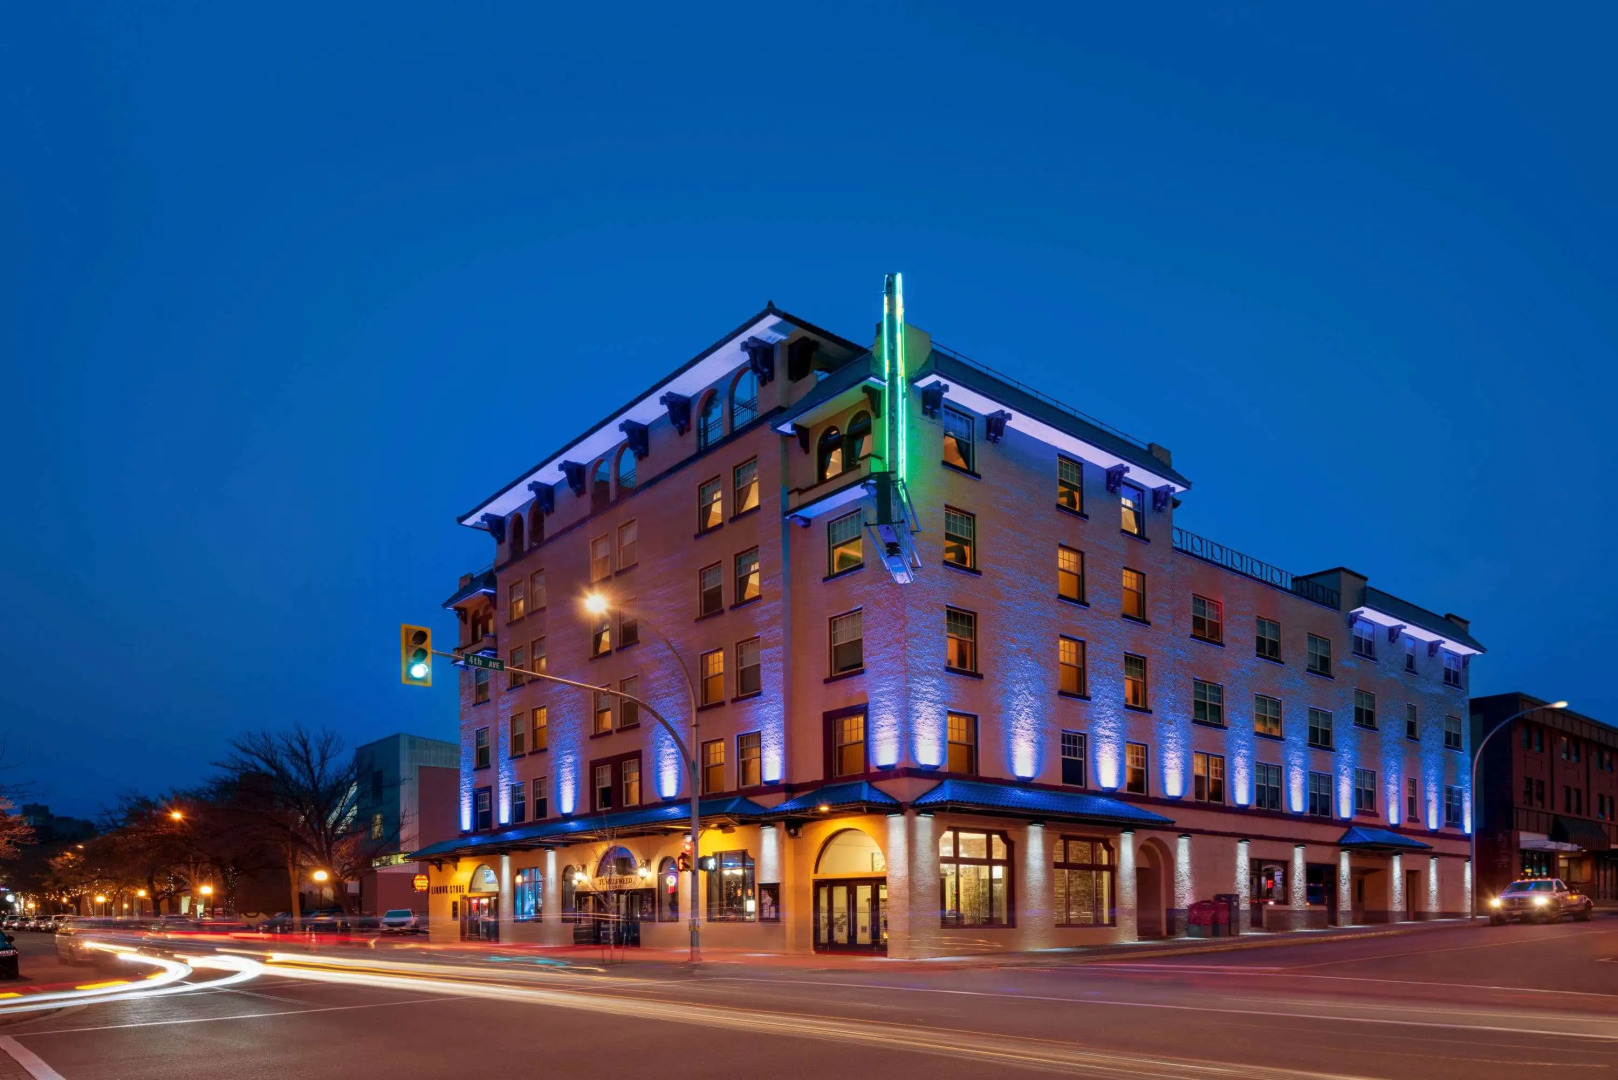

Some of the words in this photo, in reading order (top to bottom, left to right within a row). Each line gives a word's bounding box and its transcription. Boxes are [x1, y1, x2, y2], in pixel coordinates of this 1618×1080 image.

[468, 655, 482, 666] 4th
[488, 660, 501, 669] AVE
[450, 885, 464, 894] STORE
